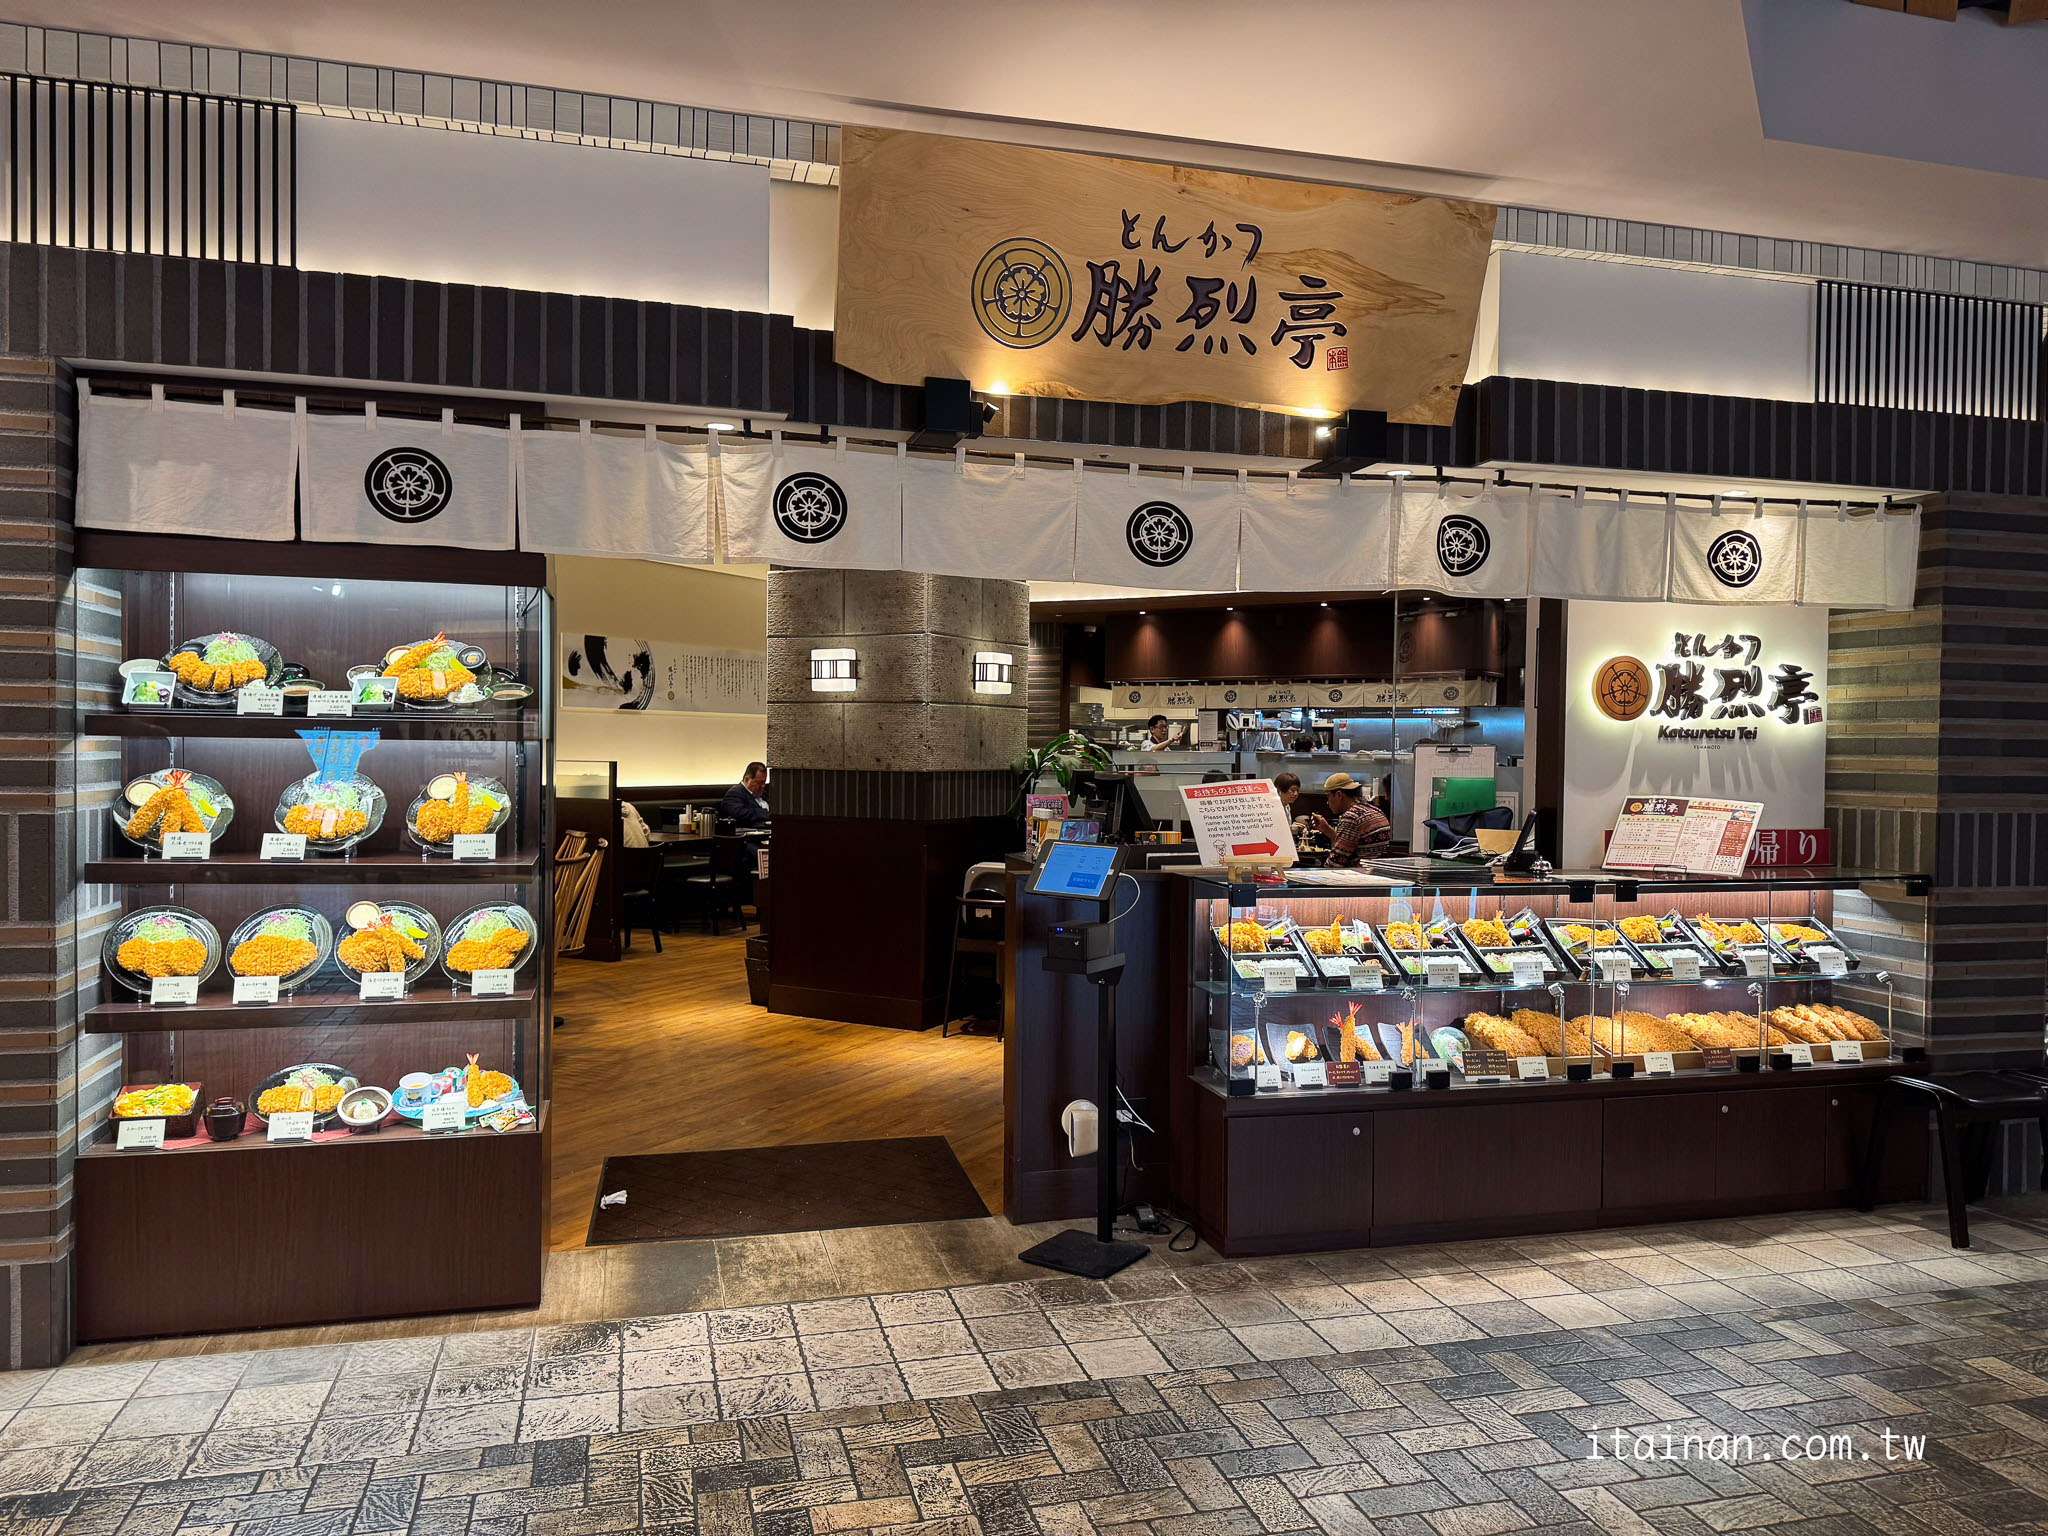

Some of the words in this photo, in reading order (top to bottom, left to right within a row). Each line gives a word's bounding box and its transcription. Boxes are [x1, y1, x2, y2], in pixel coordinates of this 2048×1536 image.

[1121, 208, 1263, 271] とんかつ
[1071, 257, 1348, 369] 勝烈亭
[1675, 632, 1762, 666] とんかつ
[1649, 660, 1819, 724] 勝烈亭
[1658, 725, 1736, 740] Katsuretsu
[1737, 726, 1759, 740] Tei
[1193, 785, 1263, 797] お待ちのお客様へ
